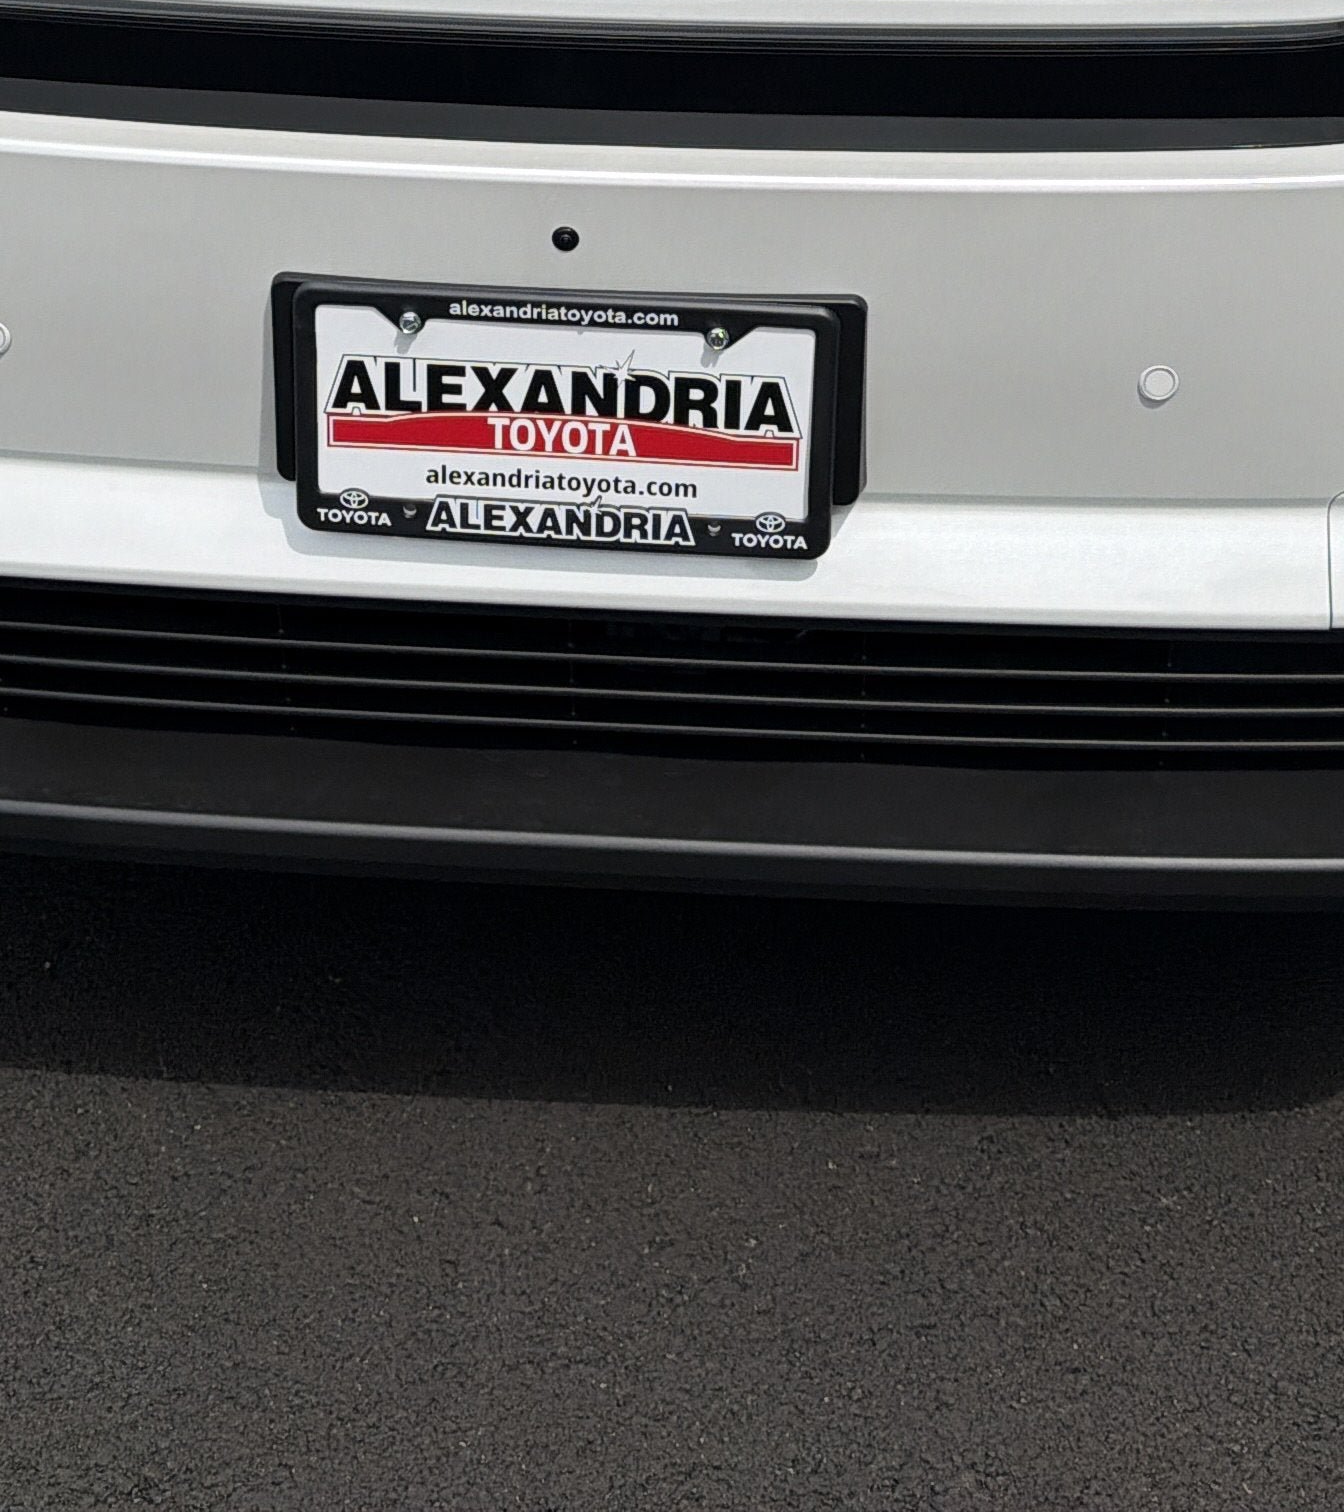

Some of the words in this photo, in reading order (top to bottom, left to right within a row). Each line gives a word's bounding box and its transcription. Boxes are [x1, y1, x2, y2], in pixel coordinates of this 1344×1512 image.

[449, 299, 679, 326] alexandriatoyota.com
[327, 355, 799, 437] ALEXANDRIA
[487, 417, 637, 457] TOYOTA
[426, 464, 697, 498] alexandriatoyota.com
[317, 507, 392, 527] TOYOTA
[425, 495, 696, 546] ALEXANDRIA
[731, 533, 808, 550] TOYOTA
